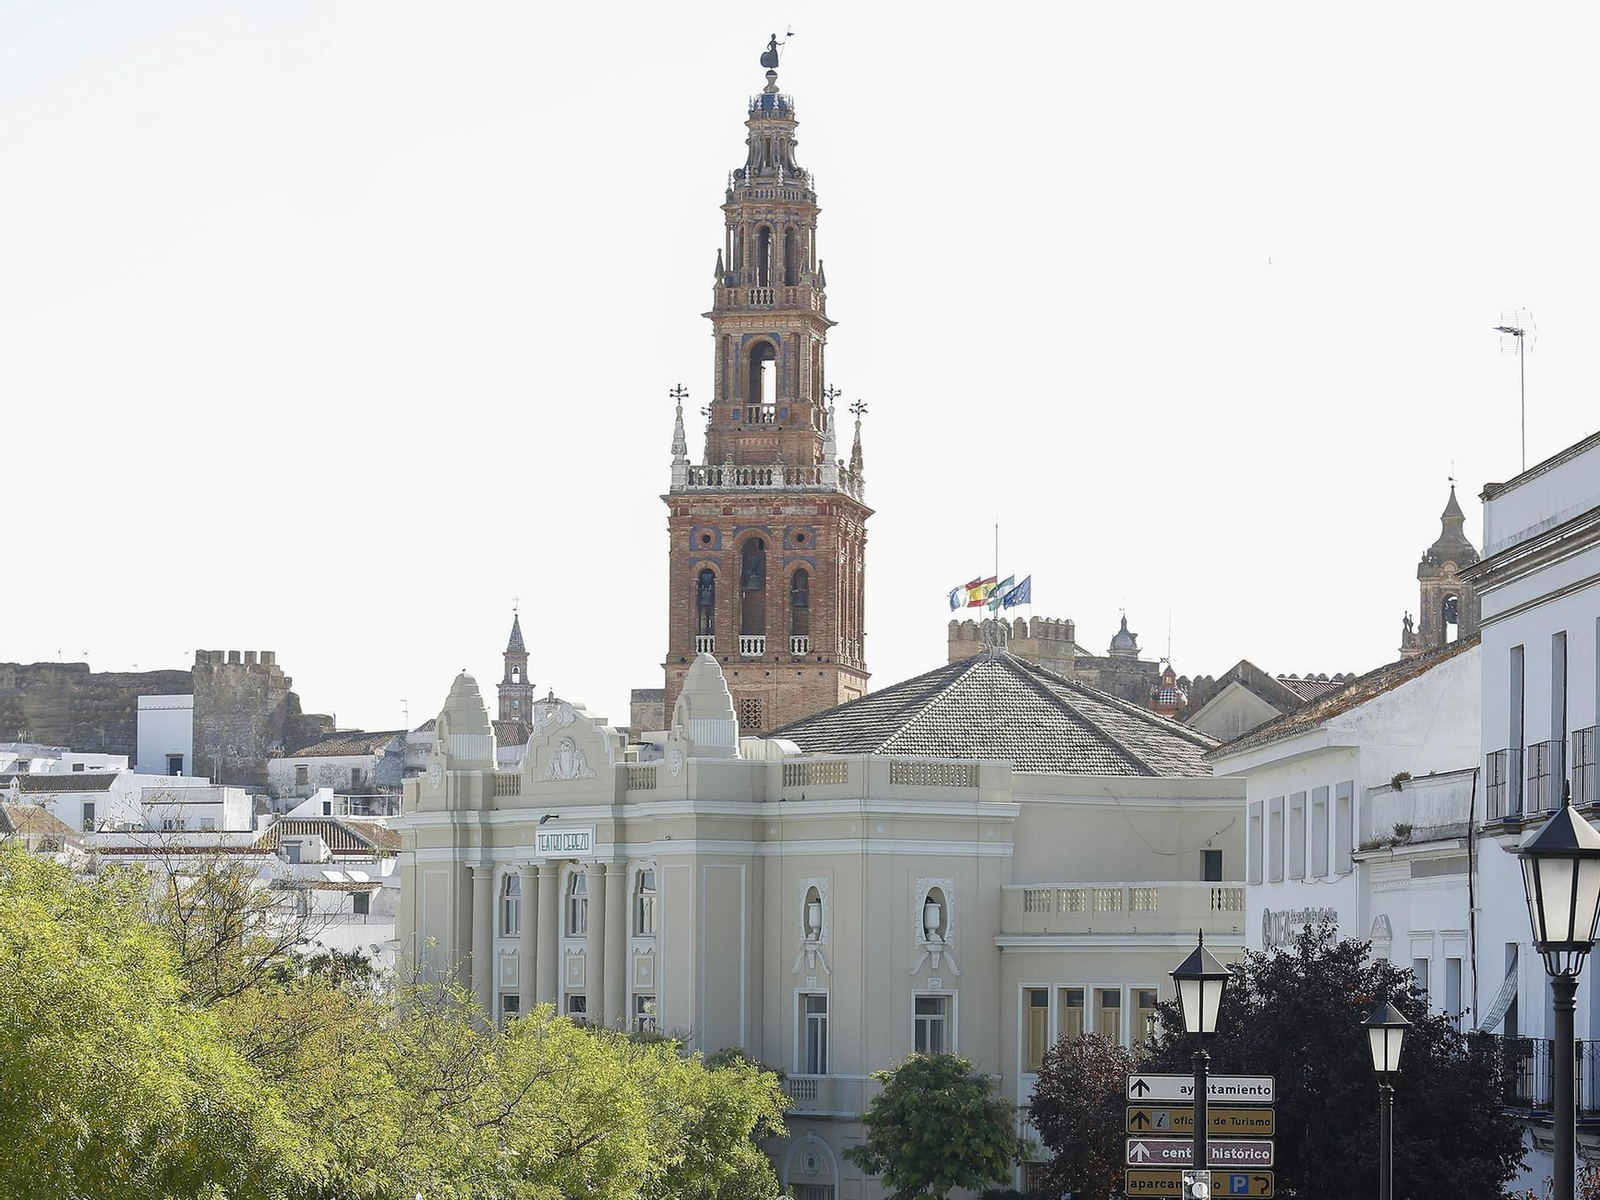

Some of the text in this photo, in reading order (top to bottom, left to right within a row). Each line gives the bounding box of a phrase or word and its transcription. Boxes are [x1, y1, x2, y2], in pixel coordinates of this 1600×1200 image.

[538, 833, 588, 851] TEATRO CEREZO
[1180, 1084, 1271, 1096] aytamiento
[1213, 1117, 1227, 1126] de
[1230, 1117, 1271, 1126] Turismo
[1162, 1148, 1270, 1160] cent histórico
